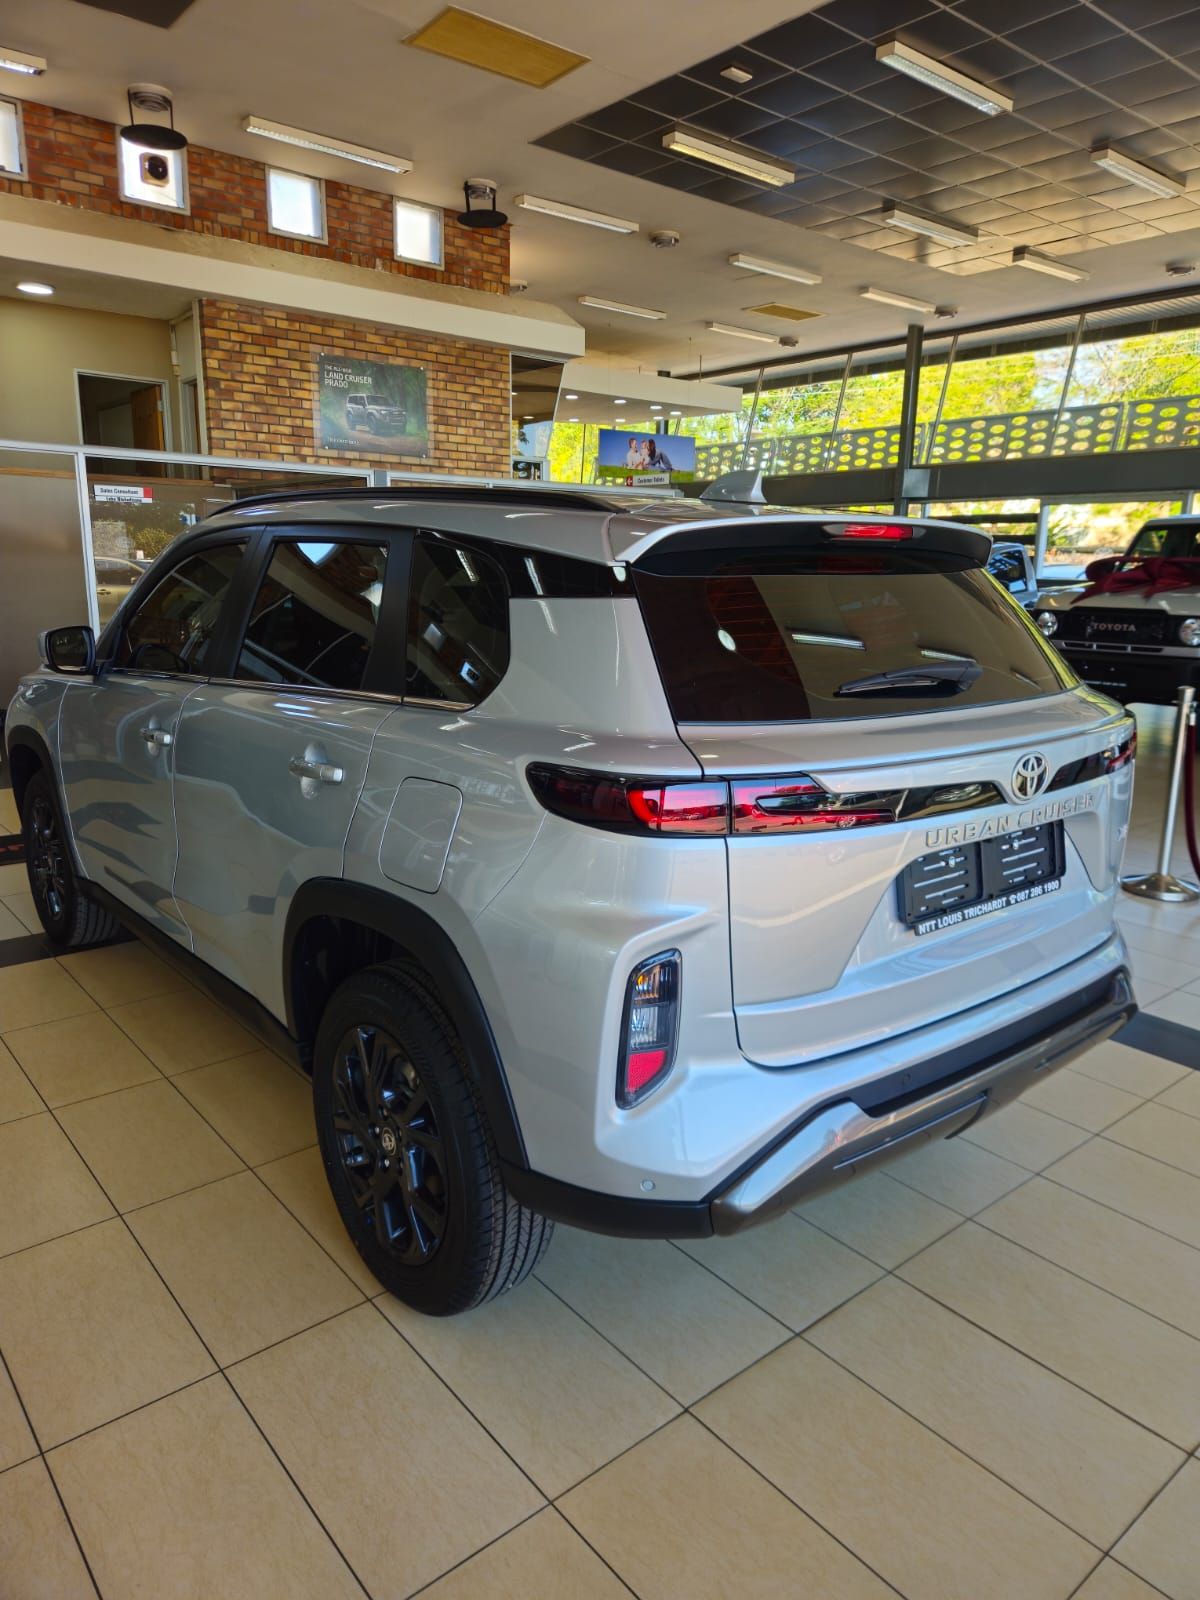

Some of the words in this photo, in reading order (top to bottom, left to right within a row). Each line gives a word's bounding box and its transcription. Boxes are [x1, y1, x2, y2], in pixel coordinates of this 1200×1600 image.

[324, 371, 344, 381] LAND
[344, 374, 373, 385] CRUISER
[324, 378, 349, 389] PRADO
[1092, 622, 1137, 632] TOYOTA
[925, 816, 1009, 848] URBAN
[1017, 792, 1097, 828] CRUISER
[918, 920, 937, 935] NTT
[938, 911, 963, 929] LOUIS
[964, 897, 1007, 920] TRICHARDT
